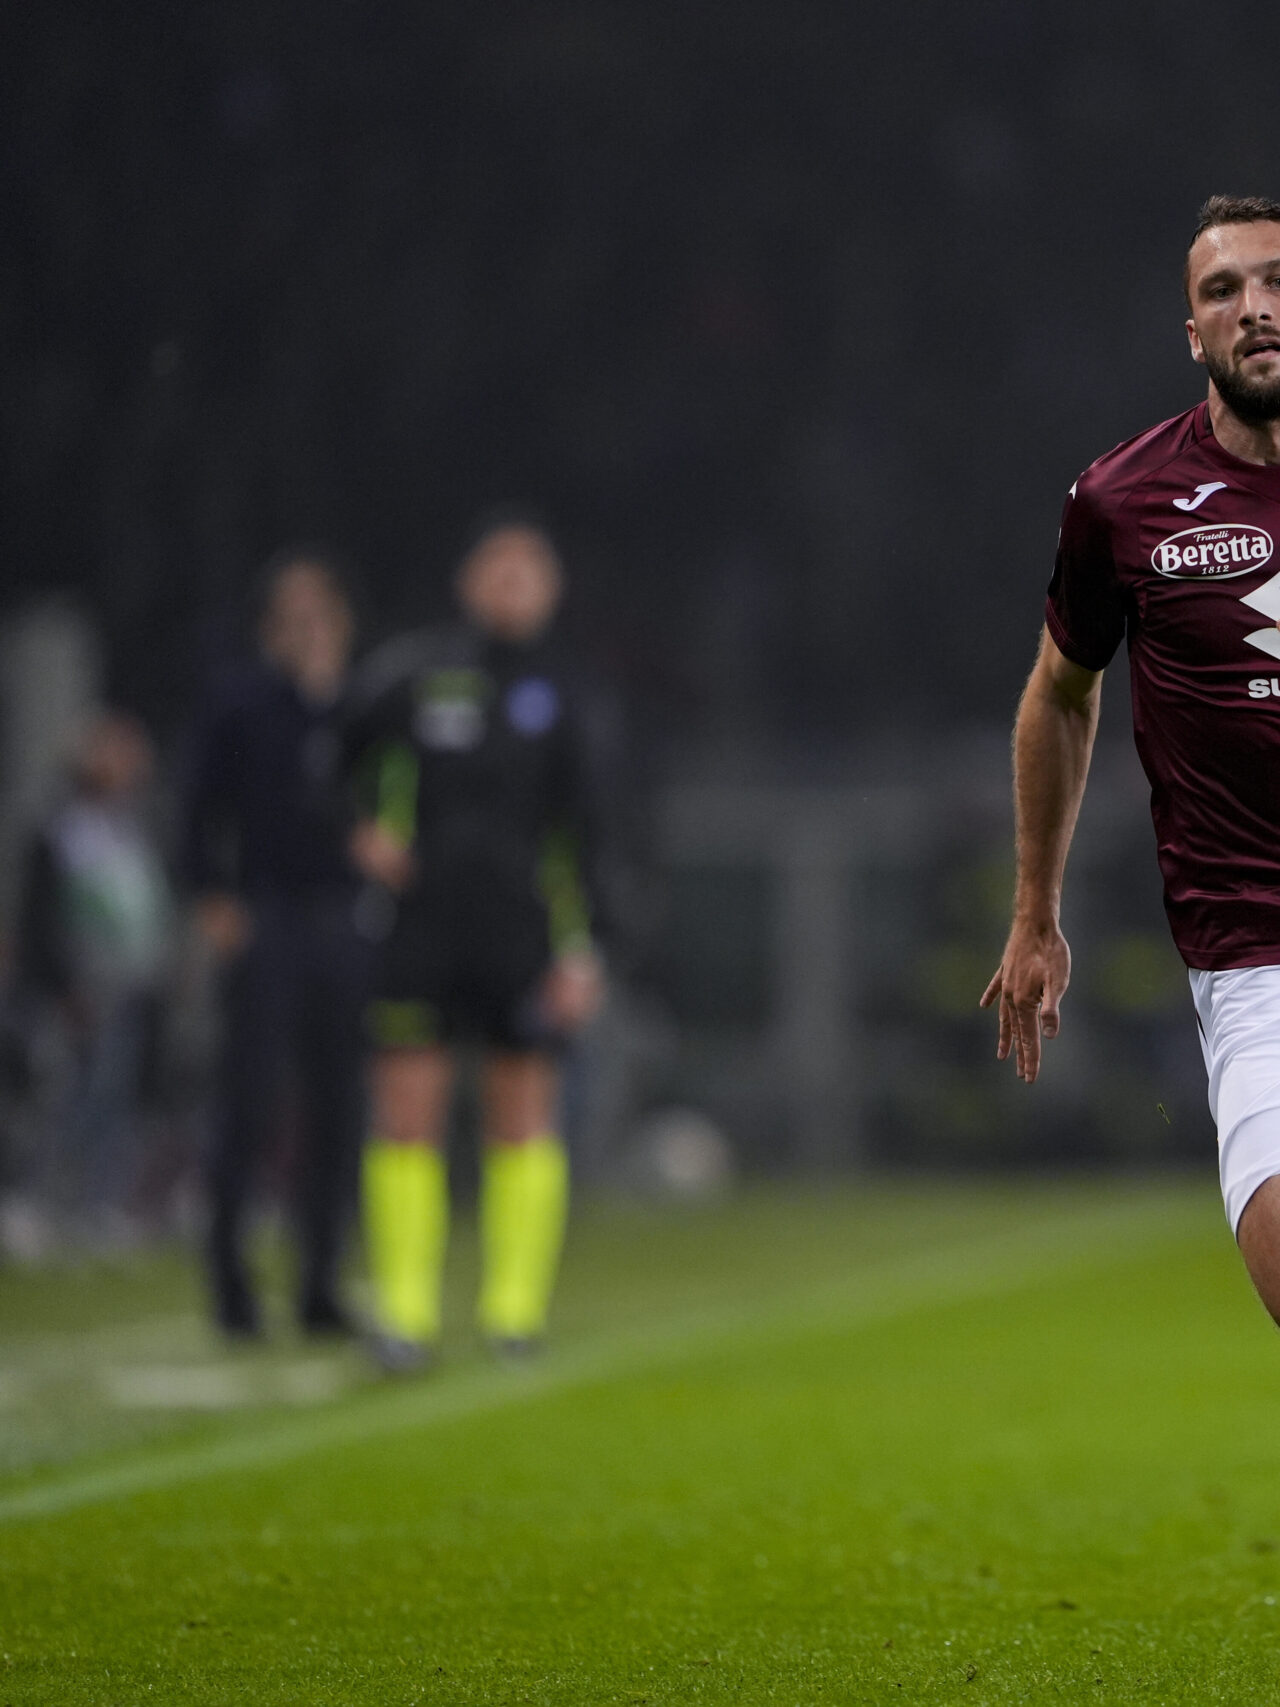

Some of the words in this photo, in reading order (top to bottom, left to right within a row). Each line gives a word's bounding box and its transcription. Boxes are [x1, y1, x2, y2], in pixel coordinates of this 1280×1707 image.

[1193, 530, 1230, 543] Fratelli
[1158, 534, 1271, 573] Beretta
[1201, 564, 1230, 575] 1812
